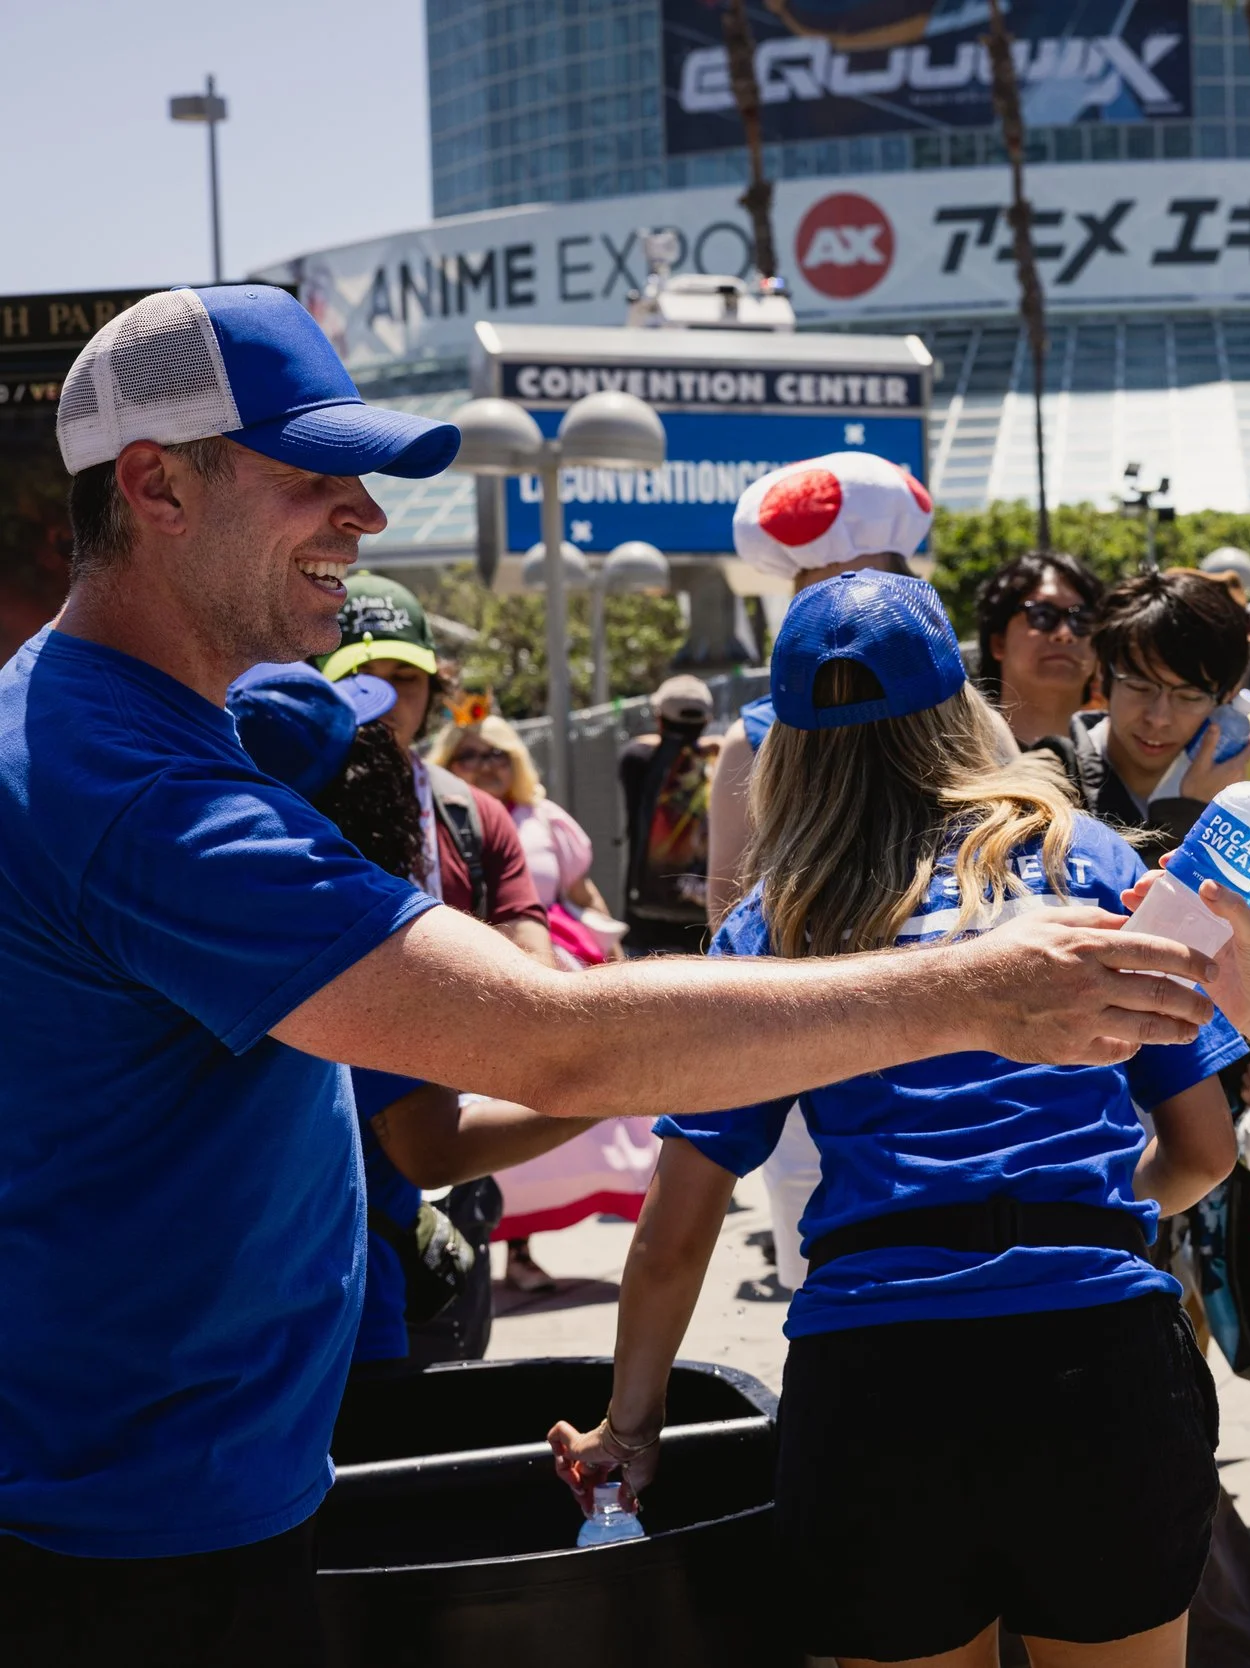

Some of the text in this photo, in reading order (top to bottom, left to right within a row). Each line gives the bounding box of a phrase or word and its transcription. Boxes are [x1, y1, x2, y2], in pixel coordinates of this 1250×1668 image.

[803, 223, 886, 269] AX
[934, 200, 1136, 285] アニメ
[367, 243, 535, 328] ANIME
[50, 300, 136, 336] PAR
[516, 365, 909, 405] CONVENTION CENTER
[942, 854, 1093, 897] SET
